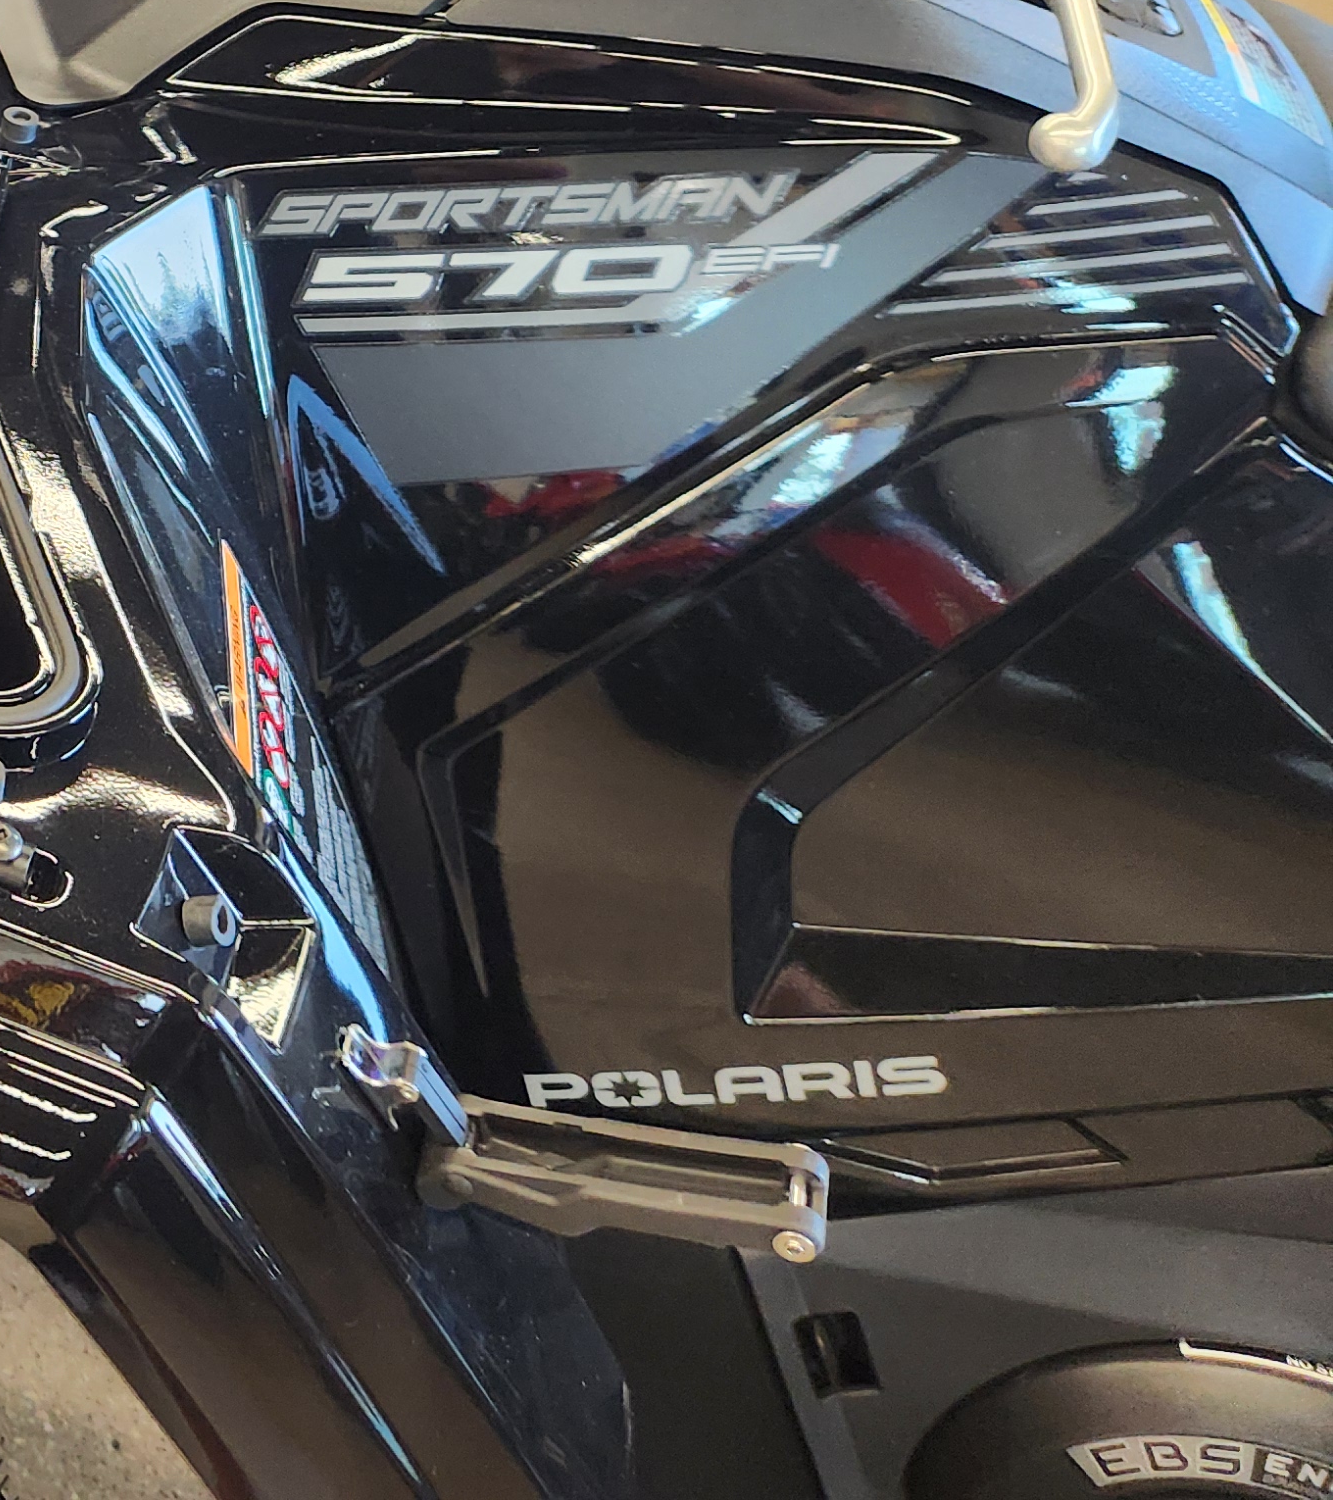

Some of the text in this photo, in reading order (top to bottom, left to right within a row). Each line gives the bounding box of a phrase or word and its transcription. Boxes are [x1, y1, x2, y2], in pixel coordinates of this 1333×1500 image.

[261, 169, 793, 236] SPORTSMAN
[301, 243, 840, 304] 570 EFI
[523, 1055, 948, 1108] POLARIS
[1089, 1440, 1243, 1478] EBS
[1263, 1452, 1333, 1490] EN
